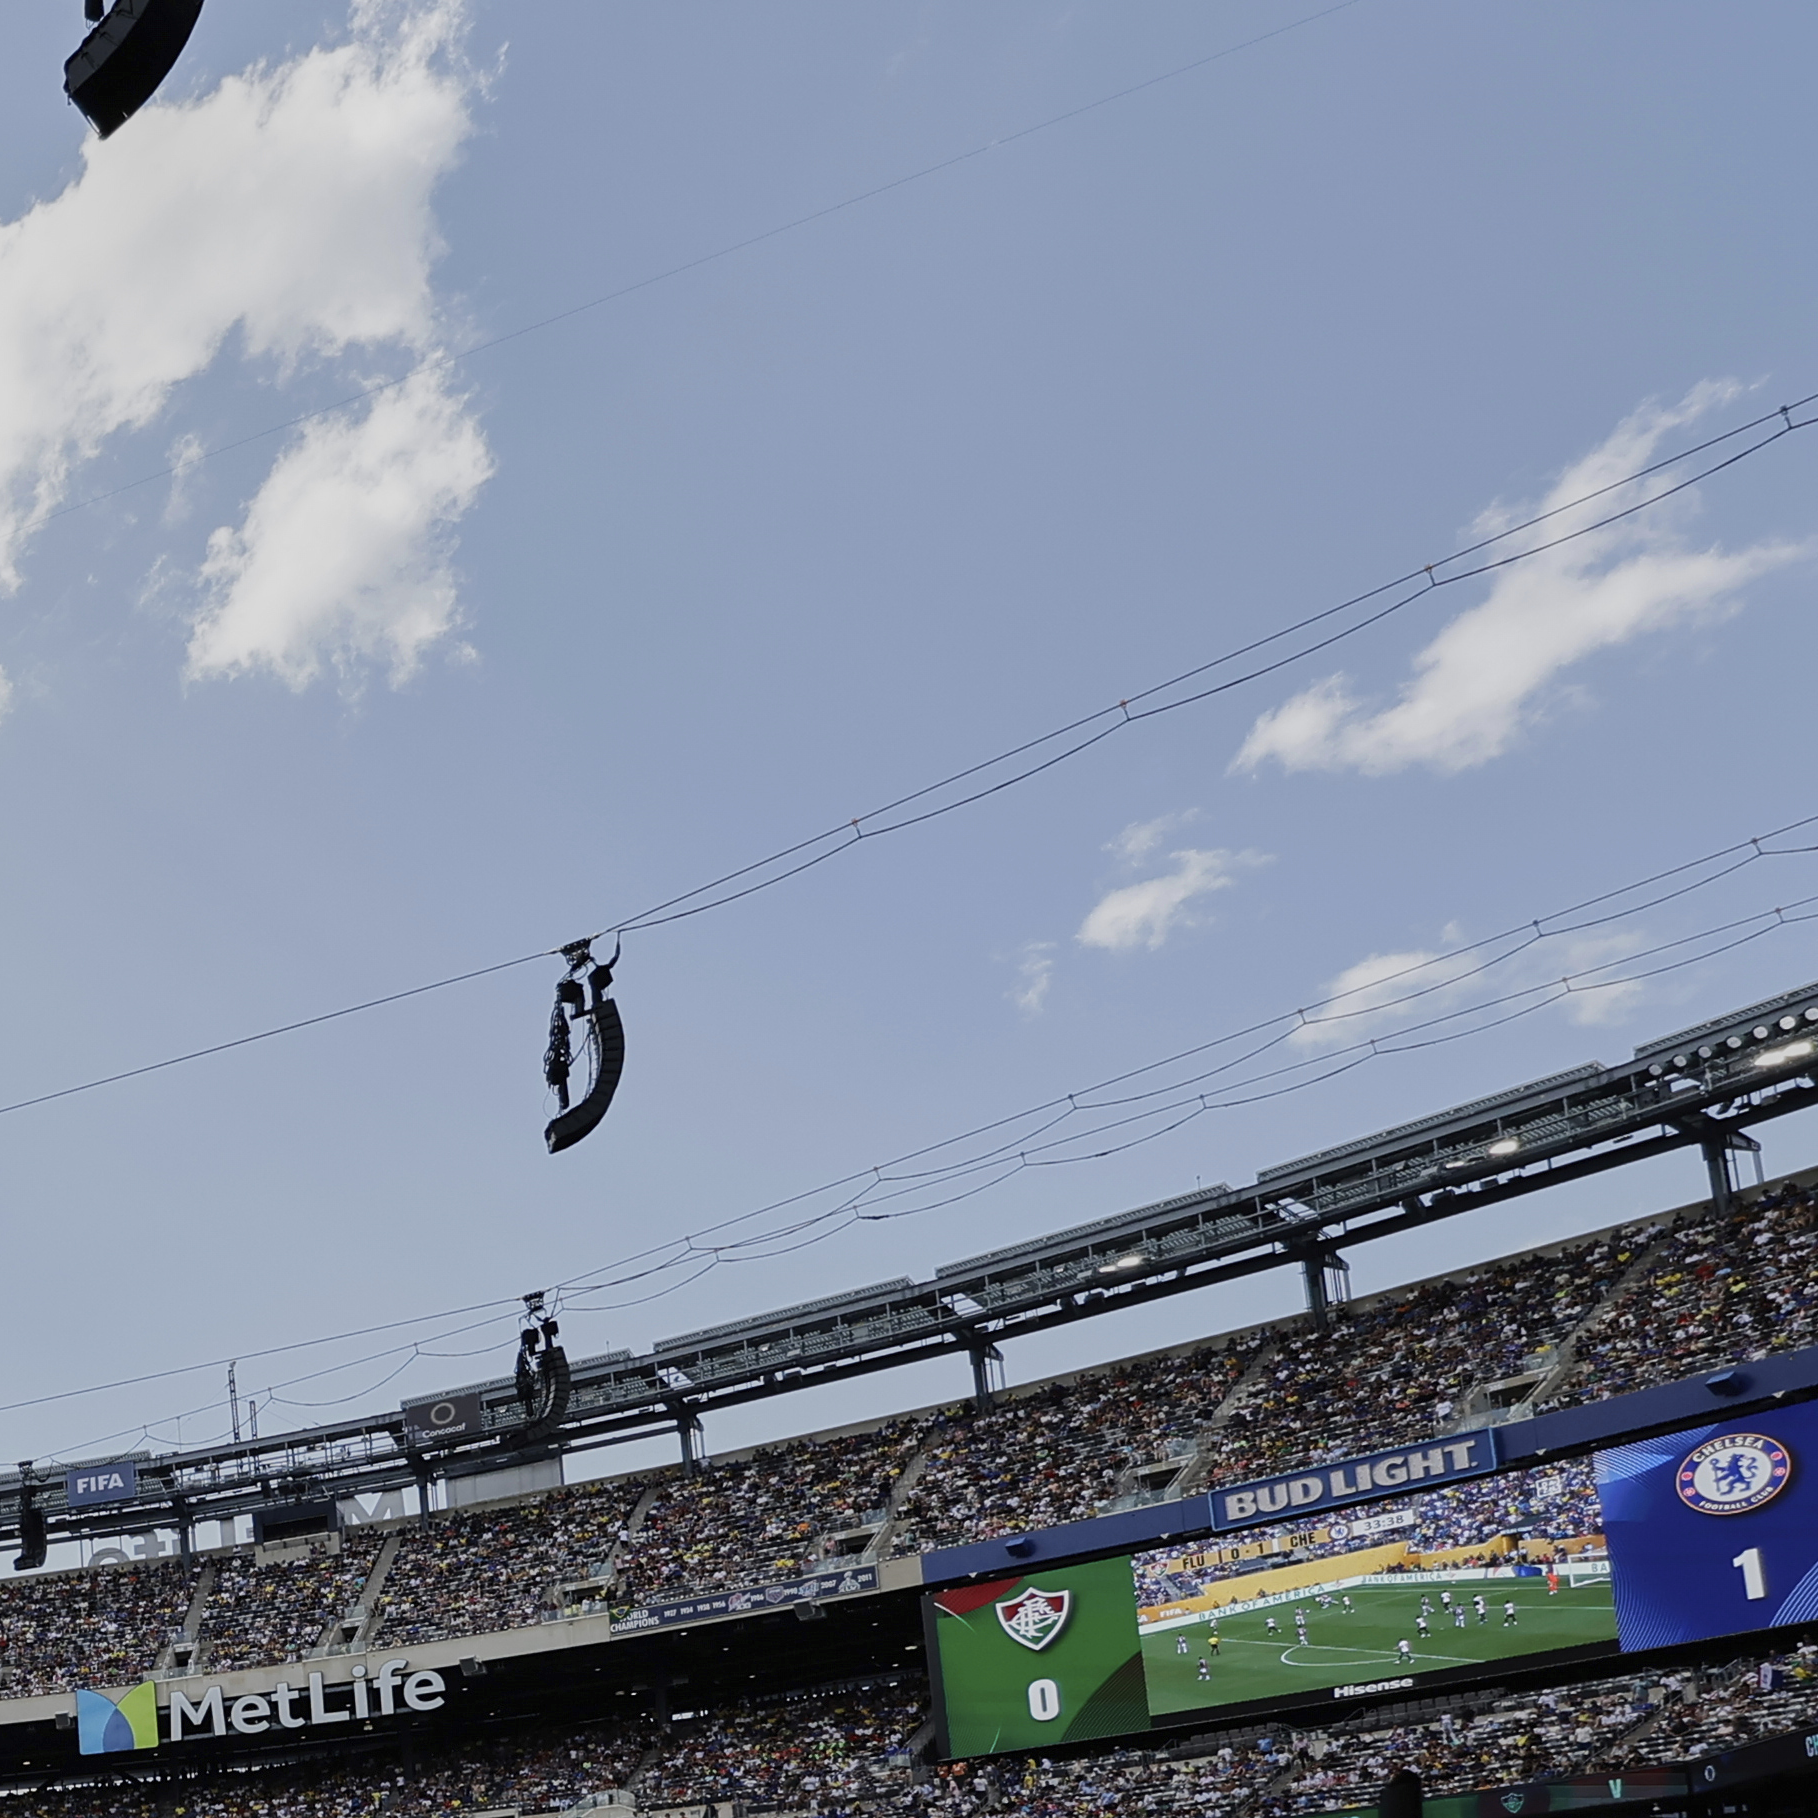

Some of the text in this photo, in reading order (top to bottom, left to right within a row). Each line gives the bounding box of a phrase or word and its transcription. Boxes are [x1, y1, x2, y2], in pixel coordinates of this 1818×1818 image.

[422, 1422, 466, 1439] Concacaf
[1691, 1436, 1765, 1463] CHELSEA
[76, 1472, 124, 1494] FIFA
[1224, 1476, 1325, 1522] BUD
[1699, 1486, 1774, 1511] FOOTBALL CLUB
[1182, 1555, 1205, 1570] FLU
[1230, 1550, 1240, 1563] 0
[1290, 1531, 1316, 1548] CHE
[1364, 1514, 1404, 1531] 33:38
[1732, 1547, 1766, 1601] 1
[1160, 1607, 1183, 1618] FIFA
[1198, 1602, 1237, 1621] BANK
[1264, 1585, 1325, 1606] AMERICA
[610, 1615, 660, 1633] CHAMPIONS
[620, 1610, 649, 1623] ORLD
[170, 1659, 447, 1742] MetLife
[1027, 1678, 1060, 1722] 0
[1333, 1677, 1414, 1699] Hisense
[1607, 1777, 1623, 1799] V
